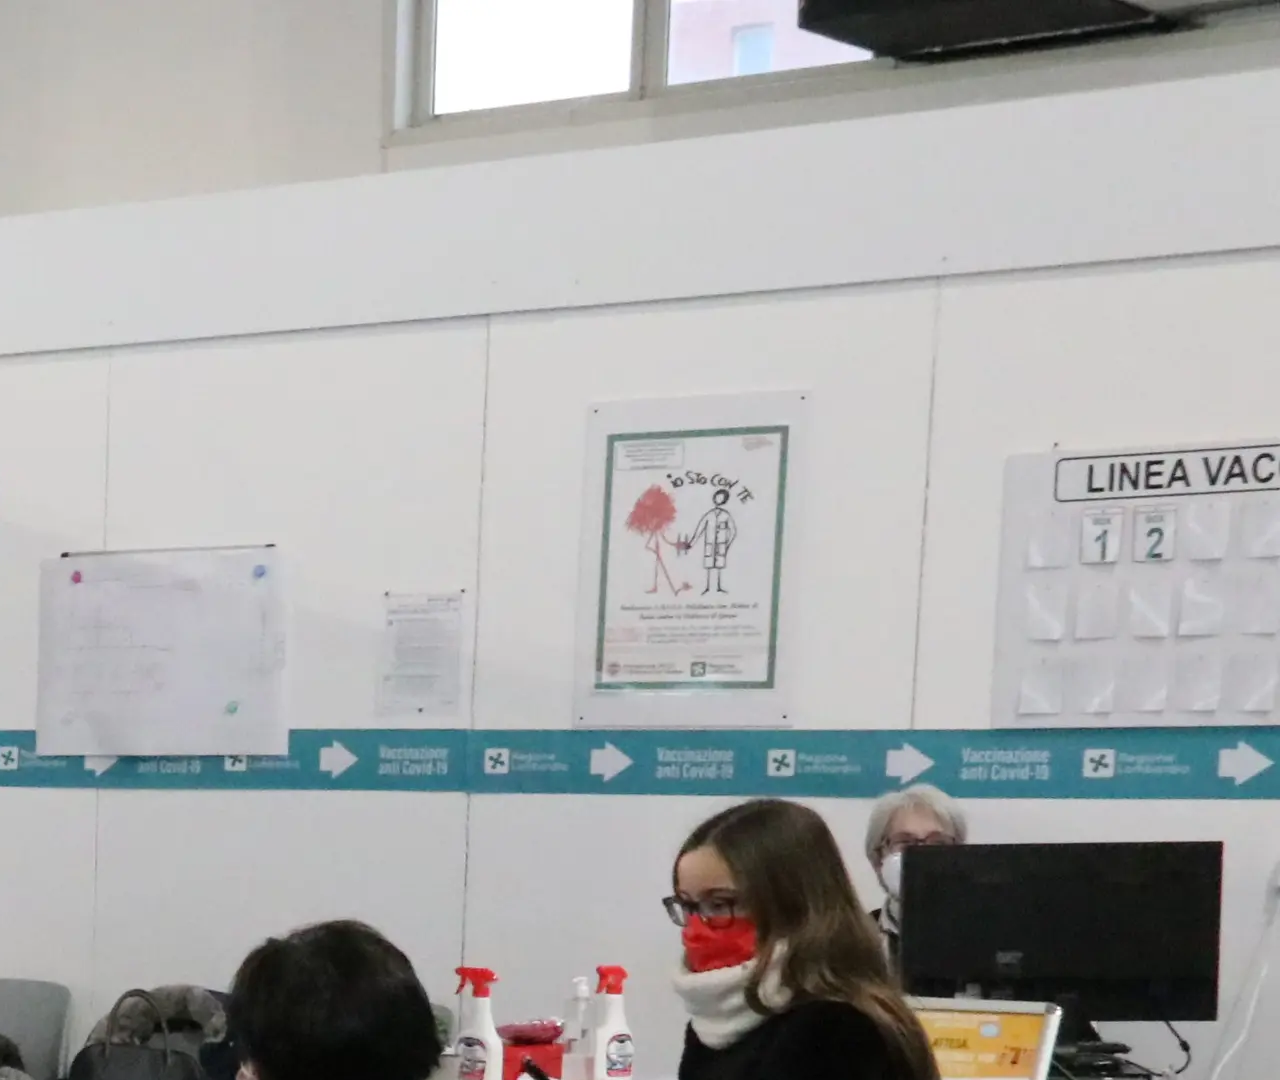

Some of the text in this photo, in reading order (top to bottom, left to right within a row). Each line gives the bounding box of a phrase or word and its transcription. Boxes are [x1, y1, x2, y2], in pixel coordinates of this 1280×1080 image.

[1087, 453, 1280, 493] LINEA VAC
[1095, 530, 1107, 560] 1
[1146, 527, 1164, 559] 2
[657, 747, 733, 762] Vaccinazione
[961, 747, 1050, 764] Vaccinazione
[379, 759, 448, 775] anti Covid-19
[656, 763, 733, 779] anti Covid-19
[960, 764, 1049, 781] anti Covid-19
